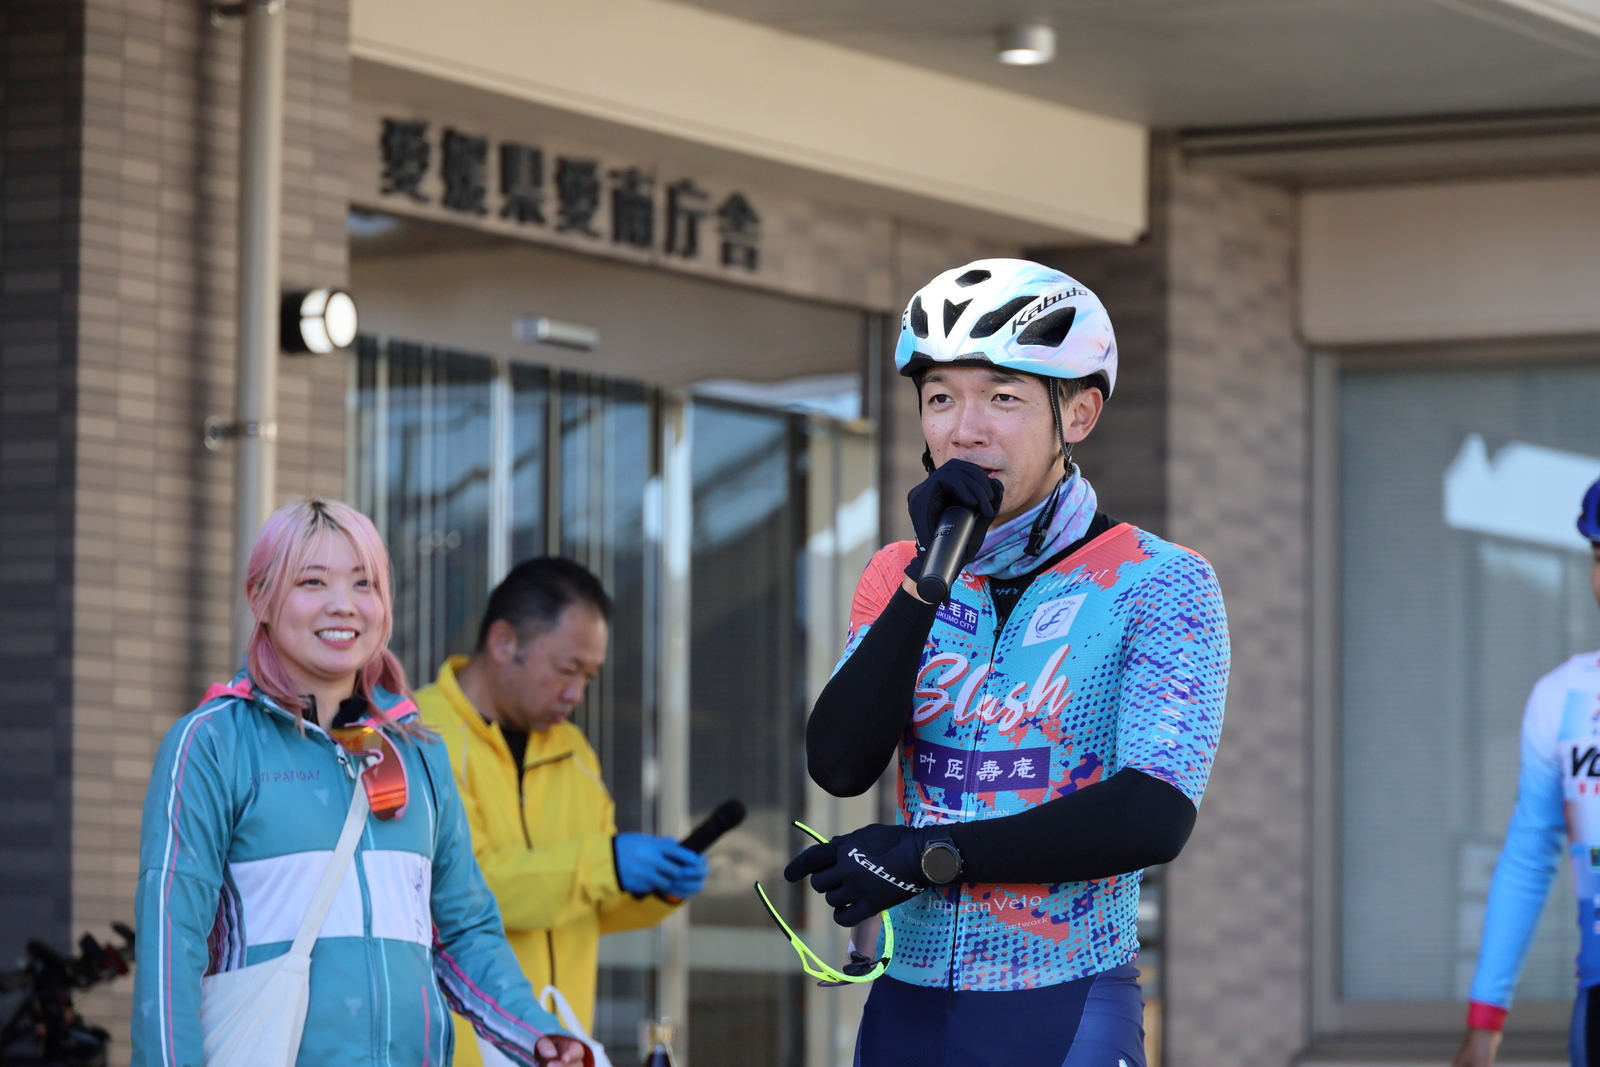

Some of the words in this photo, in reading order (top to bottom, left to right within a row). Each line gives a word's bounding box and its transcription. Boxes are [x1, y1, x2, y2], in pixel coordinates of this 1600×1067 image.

[380, 117, 762, 270] 愛媛県愛南庁舎
[1011, 286, 1088, 336] Kabuto
[959, 620, 975, 631] CITY
[913, 643, 1076, 736] Slash
[982, 809, 1010, 820] JAPAN
[847, 847, 925, 894] Kabuto
